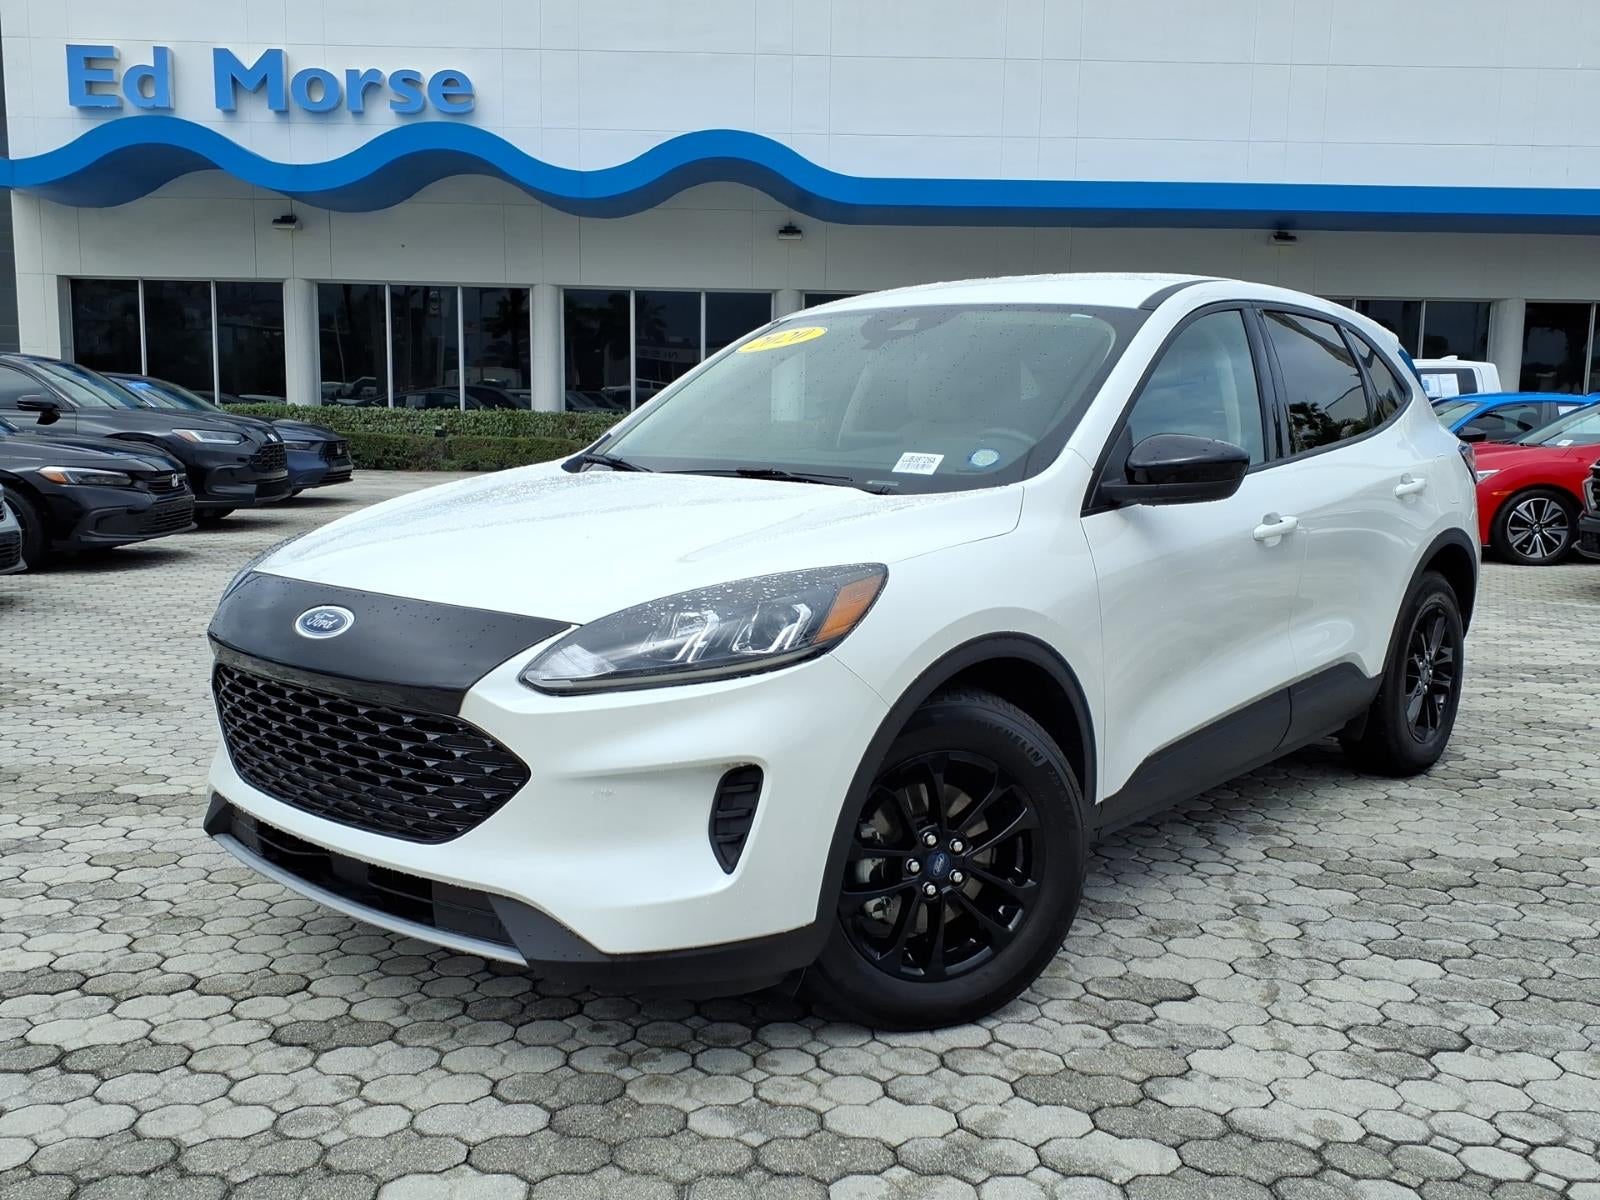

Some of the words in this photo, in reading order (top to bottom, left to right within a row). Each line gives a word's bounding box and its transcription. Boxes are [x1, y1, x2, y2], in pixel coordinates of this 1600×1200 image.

[65, 44, 175, 110] Ed
[213, 47, 477, 114] Morse
[307, 612, 338, 629] Ford
[977, 721, 1043, 762] MICHELIN
